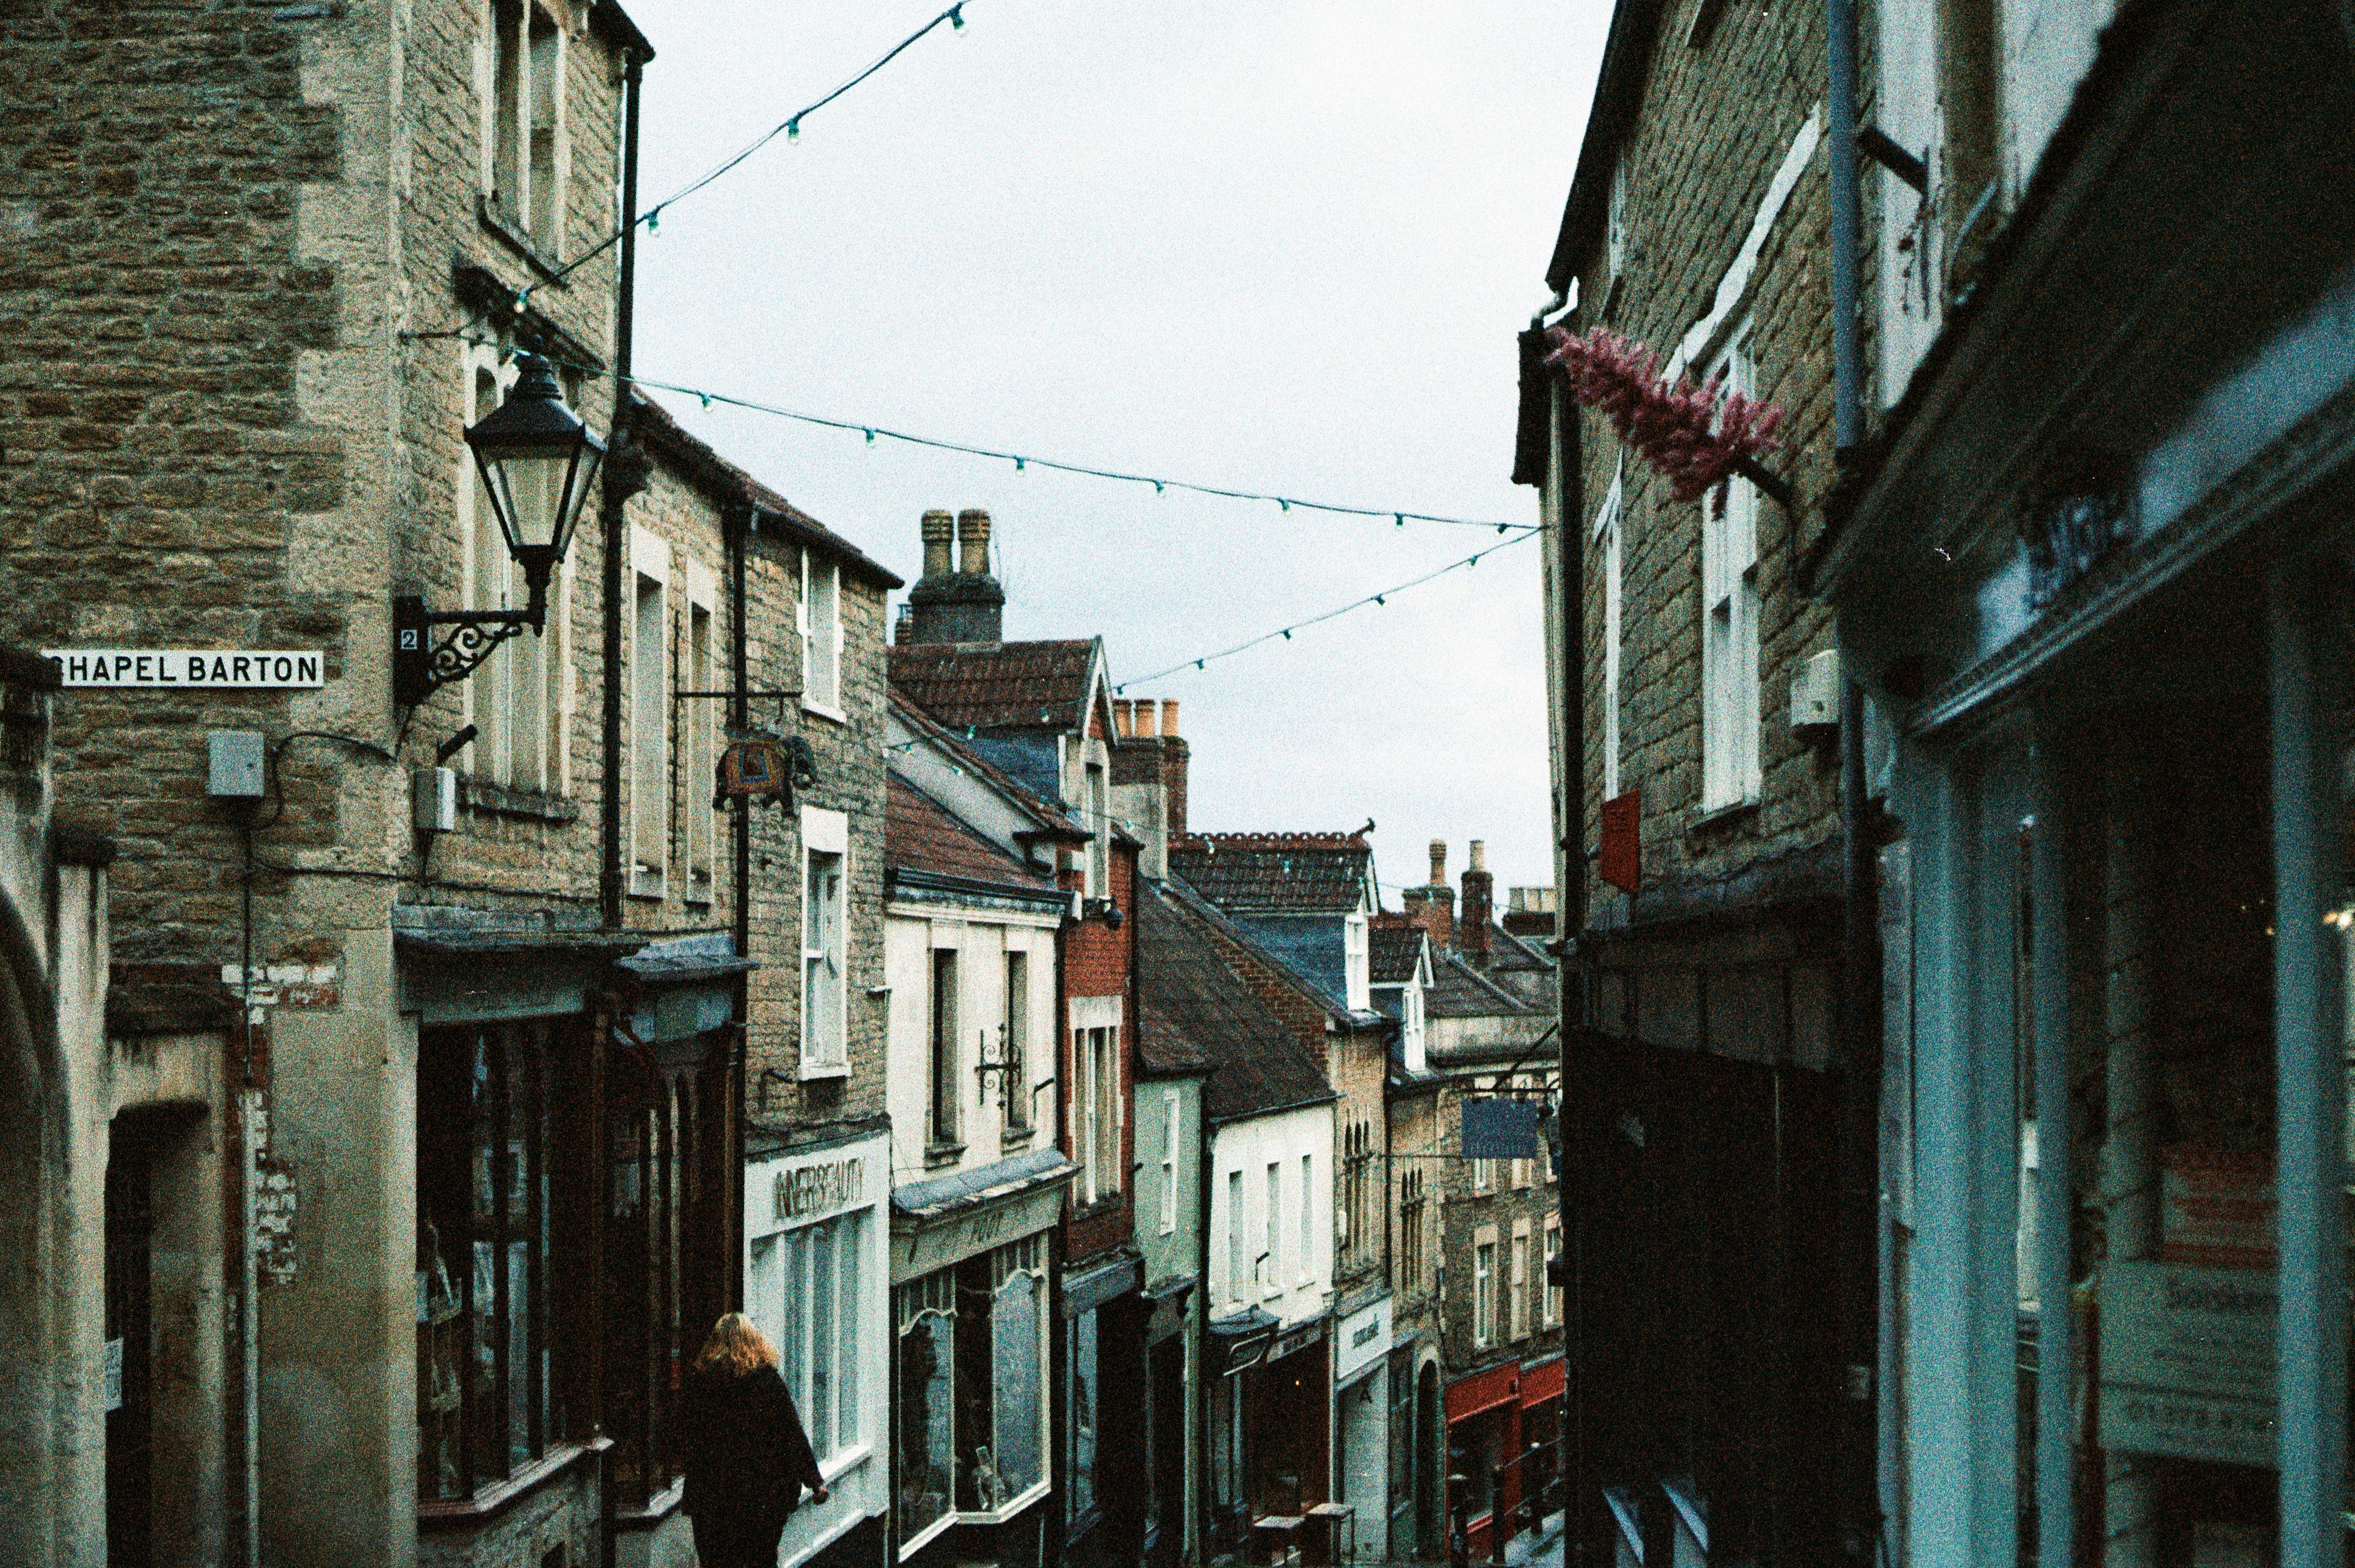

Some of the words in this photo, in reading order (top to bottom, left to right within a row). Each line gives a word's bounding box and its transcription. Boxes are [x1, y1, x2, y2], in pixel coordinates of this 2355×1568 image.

[403, 631, 415, 648] 2
[51, 656, 177, 681] HAPEL
[188, 656, 316, 682] BARTON
